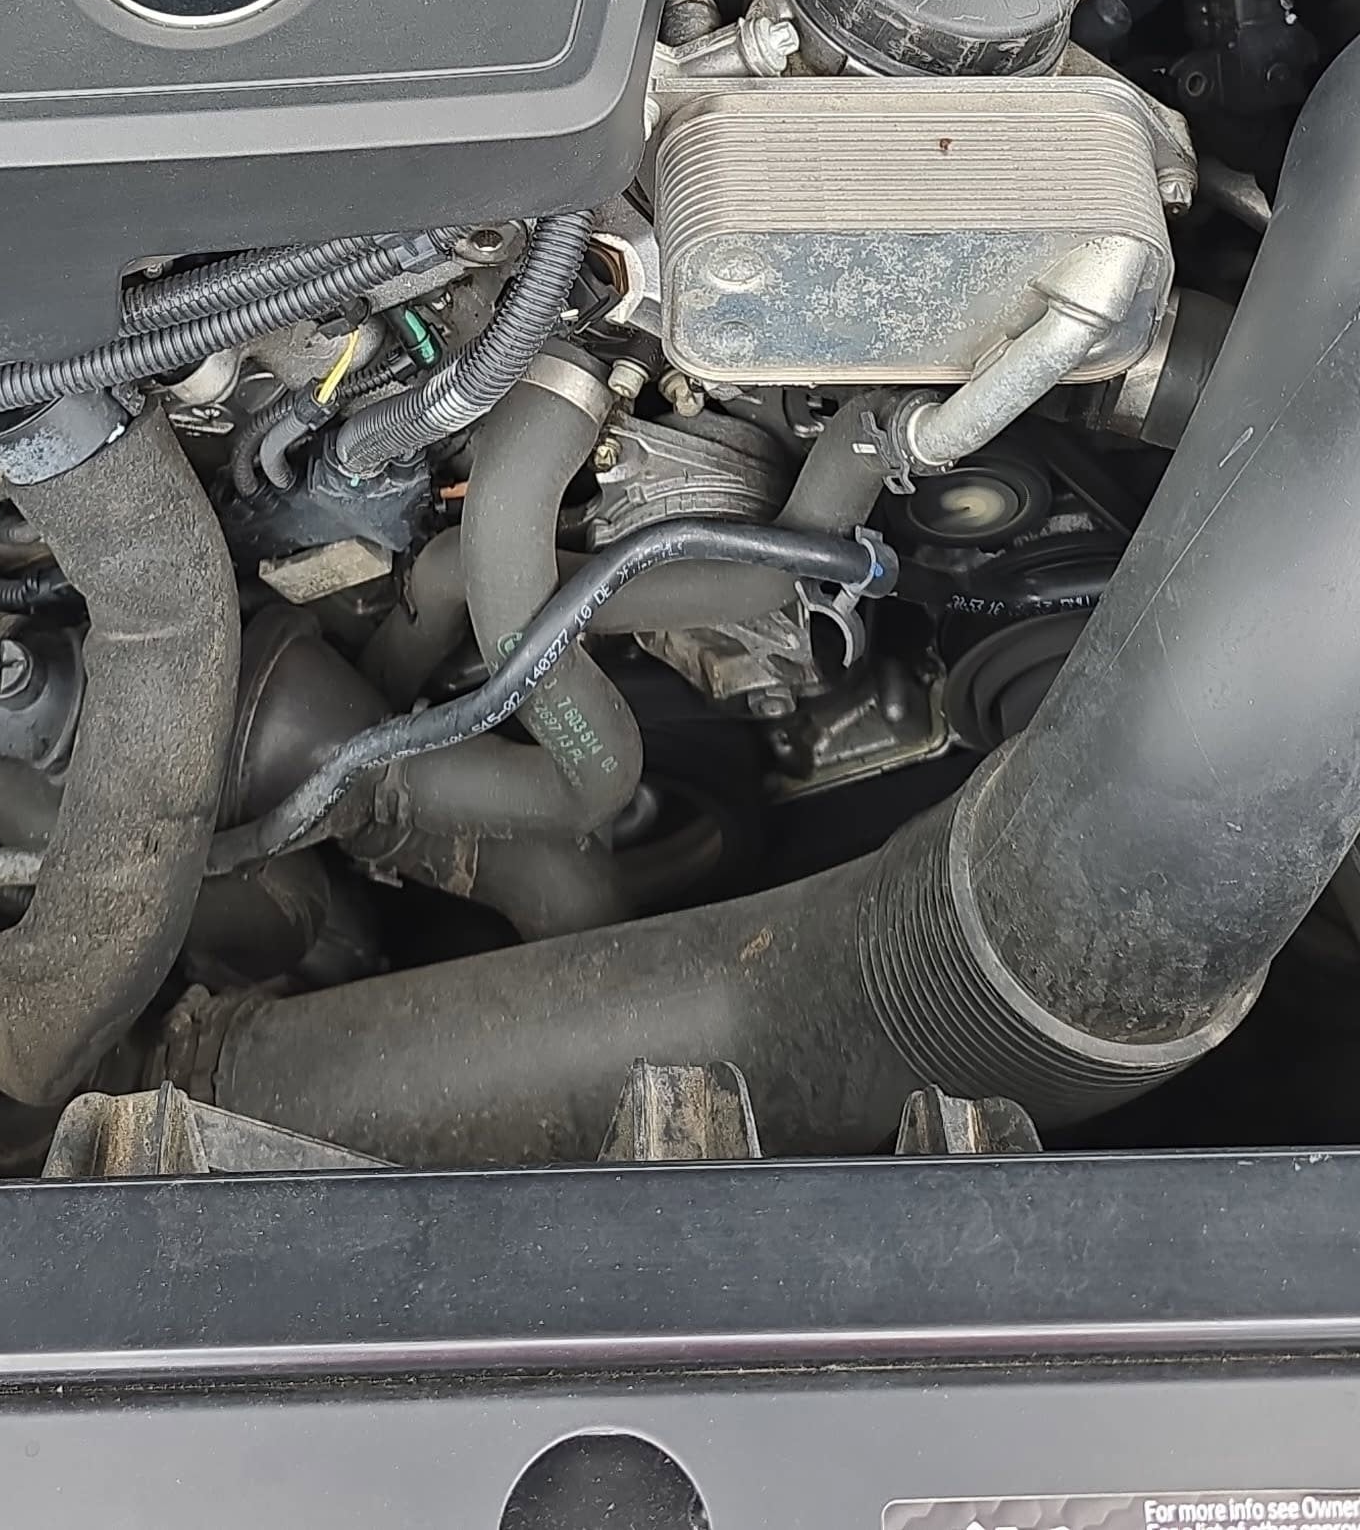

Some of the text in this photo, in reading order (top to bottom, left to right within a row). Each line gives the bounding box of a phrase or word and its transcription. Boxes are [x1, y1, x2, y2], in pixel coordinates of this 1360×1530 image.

[525, 628, 569, 689] 140327
[574, 605, 592, 631] 10
[593, 582, 613, 606] DE
[1144, 1500, 1176, 1523] For
[1179, 1503, 1227, 1522] more
[1229, 1498, 1265, 1522] info
[1267, 1501, 1301, 1521] see
